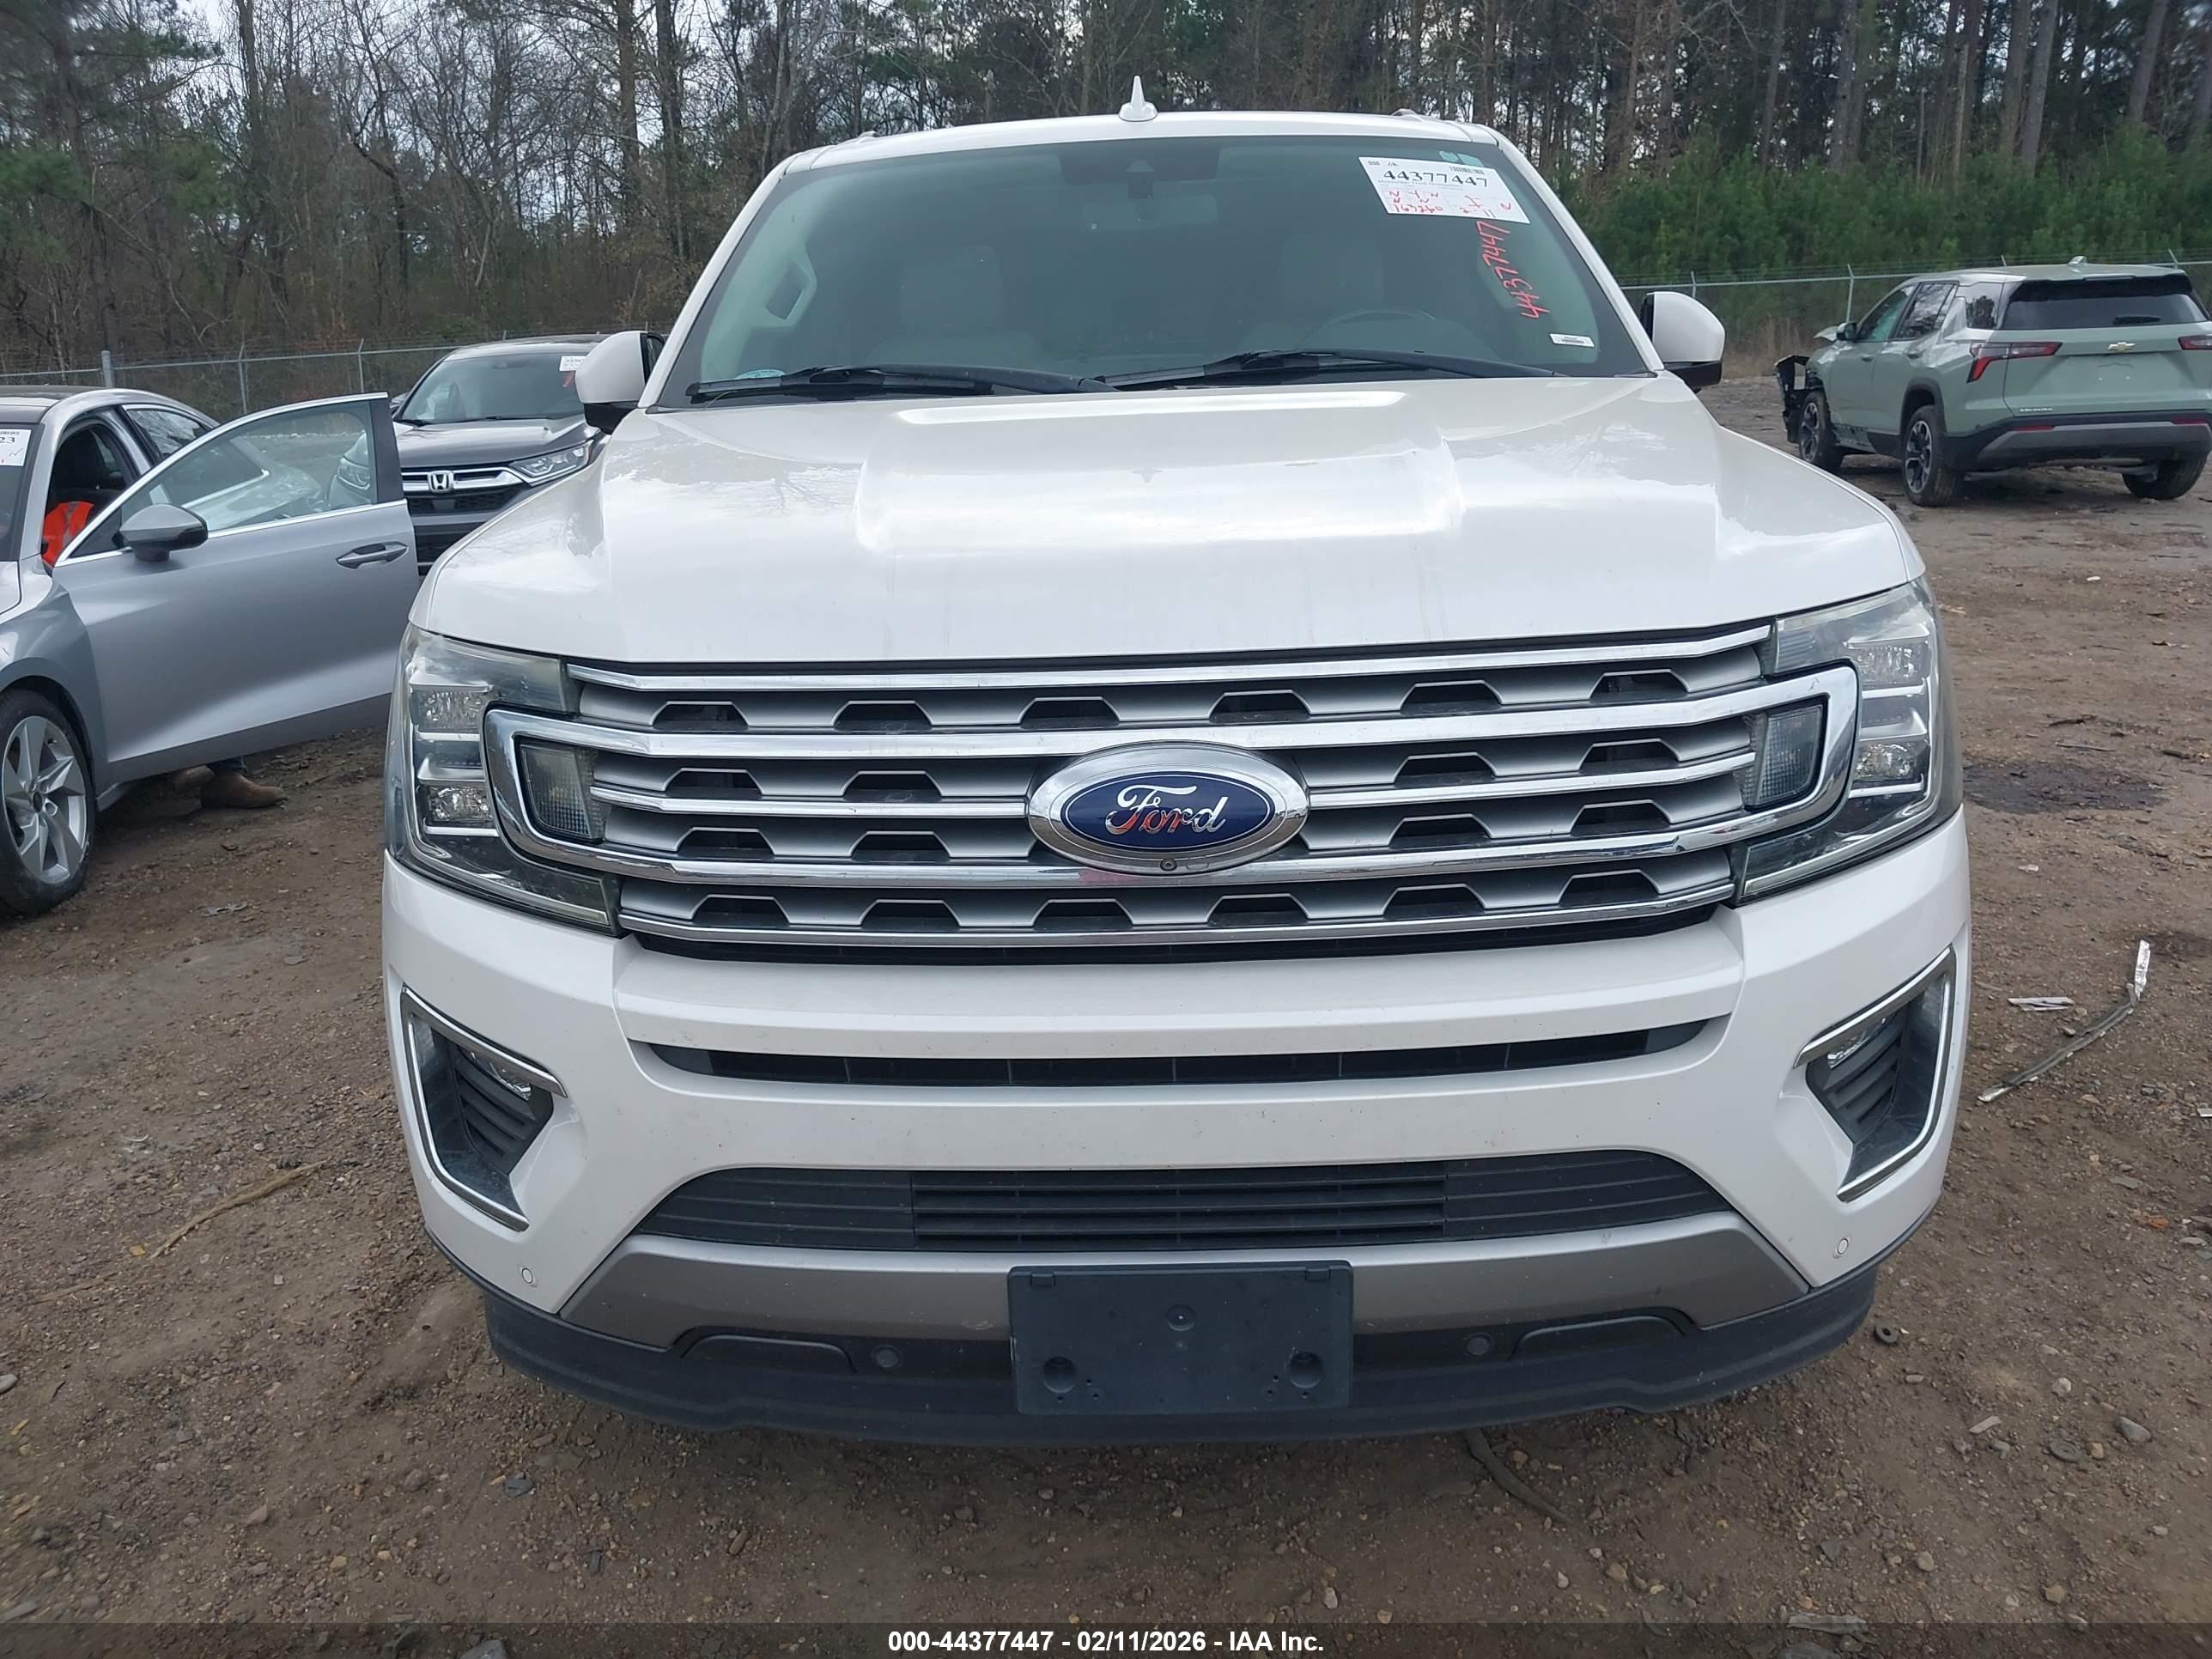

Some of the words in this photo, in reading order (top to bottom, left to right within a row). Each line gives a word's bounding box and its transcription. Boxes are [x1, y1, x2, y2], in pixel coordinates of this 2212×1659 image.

[1383, 170, 1487, 187] 44377447
[1477, 221, 1551, 319] 44377447
[1105, 784, 1229, 835] Ford
